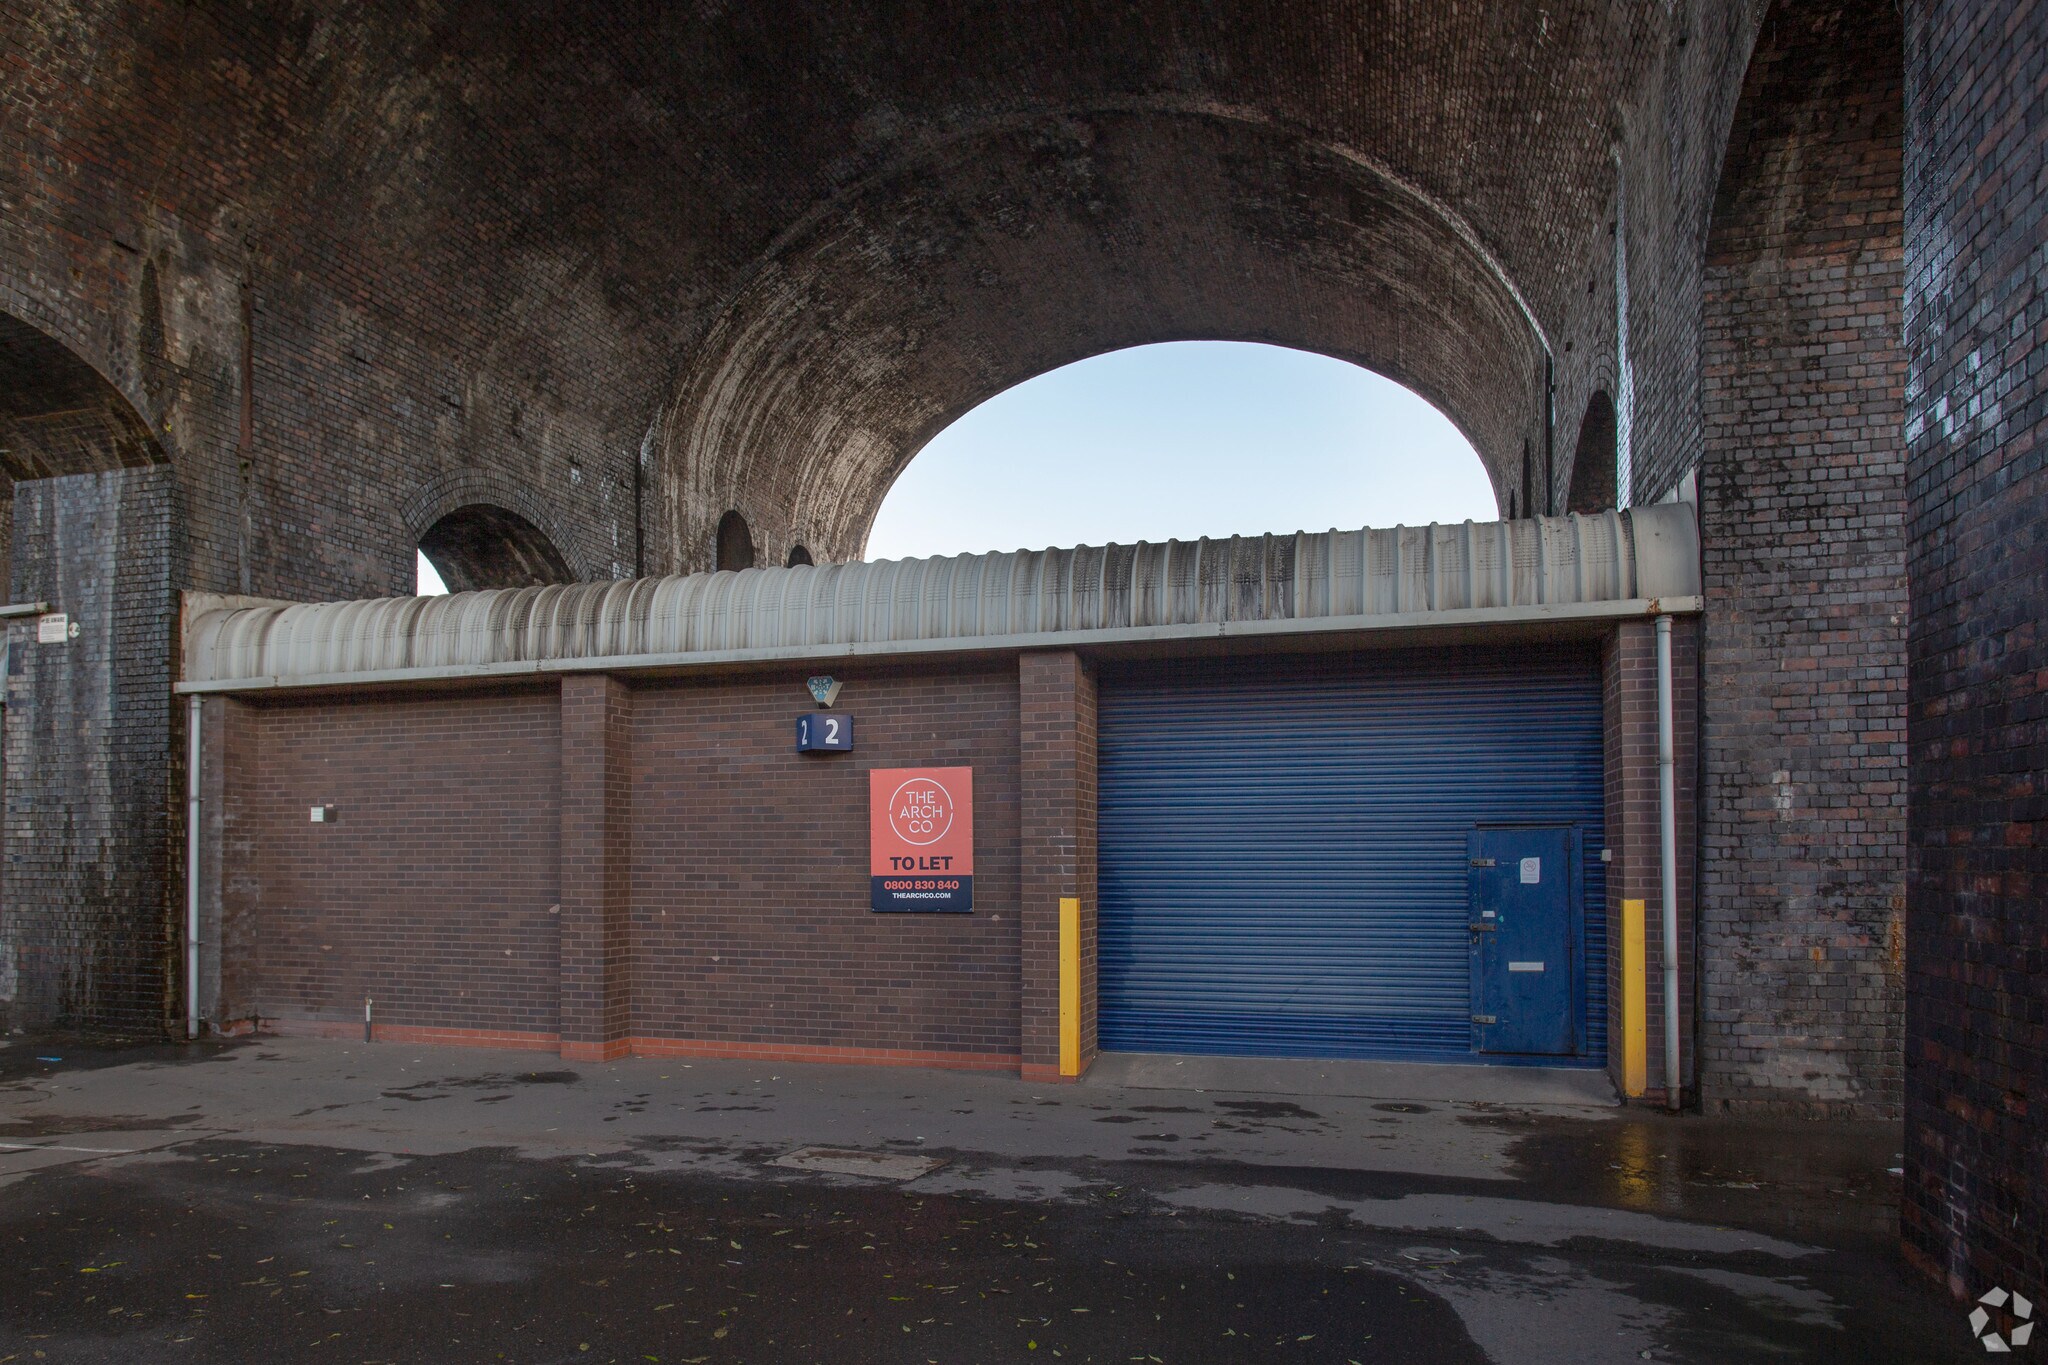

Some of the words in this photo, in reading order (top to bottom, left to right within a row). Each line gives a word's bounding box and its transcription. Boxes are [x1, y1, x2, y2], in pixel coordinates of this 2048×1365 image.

[801, 720, 808, 745] 2
[825, 718, 839, 744] 2
[906, 791, 935, 804] THE
[900, 805, 943, 819] ARCH
[909, 820, 933, 833] CO
[889, 856, 915, 870] TO
[919, 856, 953, 870] LET
[884, 880, 913, 890] 0800
[914, 880, 935, 890] 830
[937, 880, 959, 890] 840
